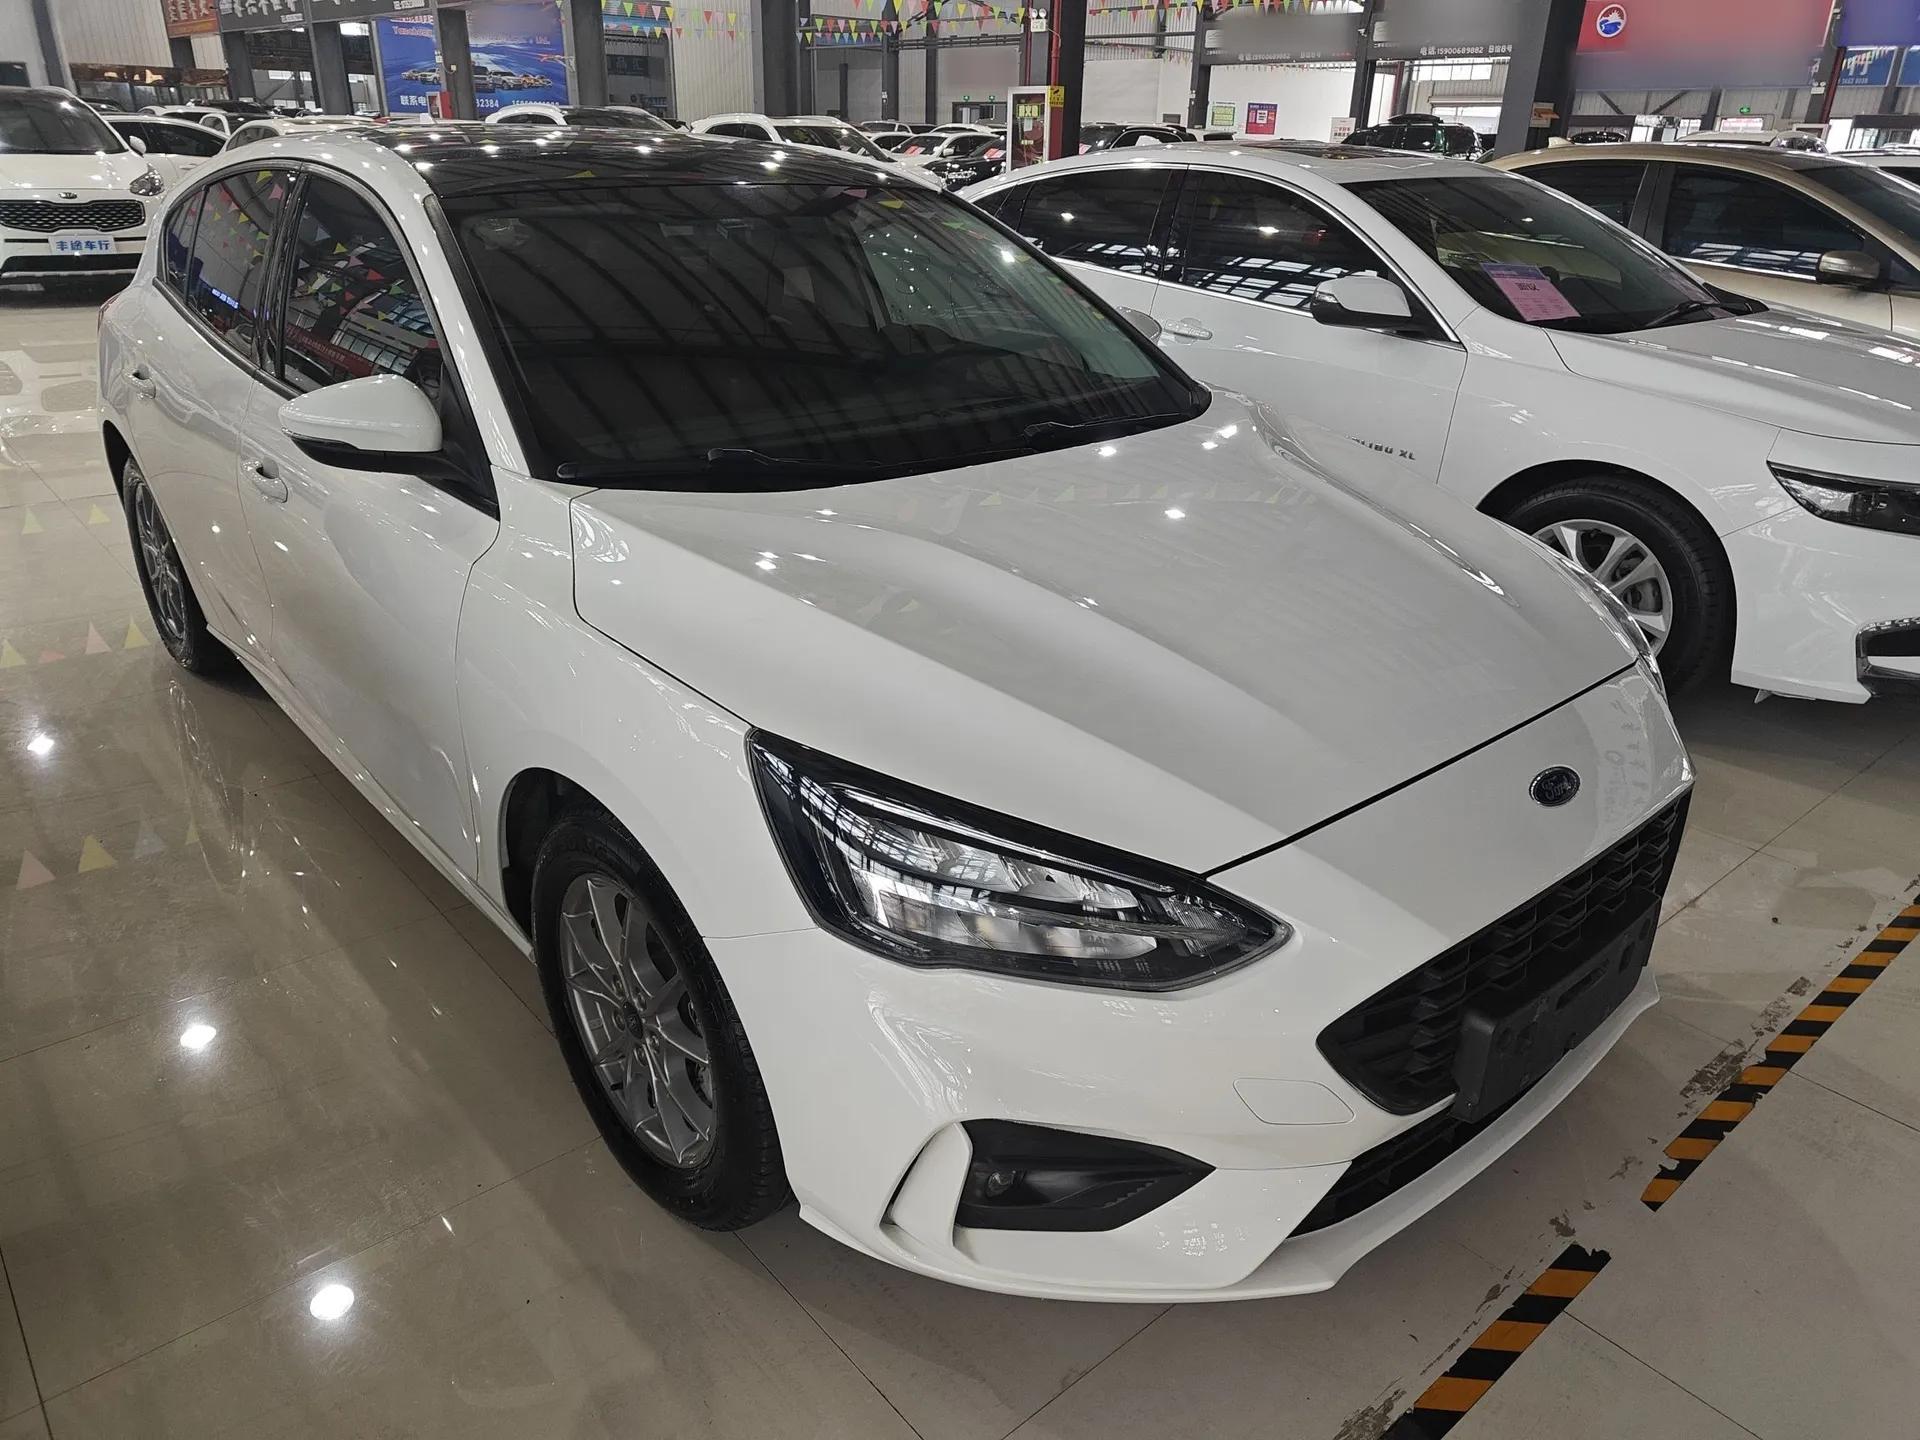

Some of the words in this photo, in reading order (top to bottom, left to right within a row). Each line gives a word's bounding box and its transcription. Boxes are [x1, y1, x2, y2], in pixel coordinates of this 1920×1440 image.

[56, 240, 110, 251] 丰途车行
[1398, 449, 1416, 461] XL
